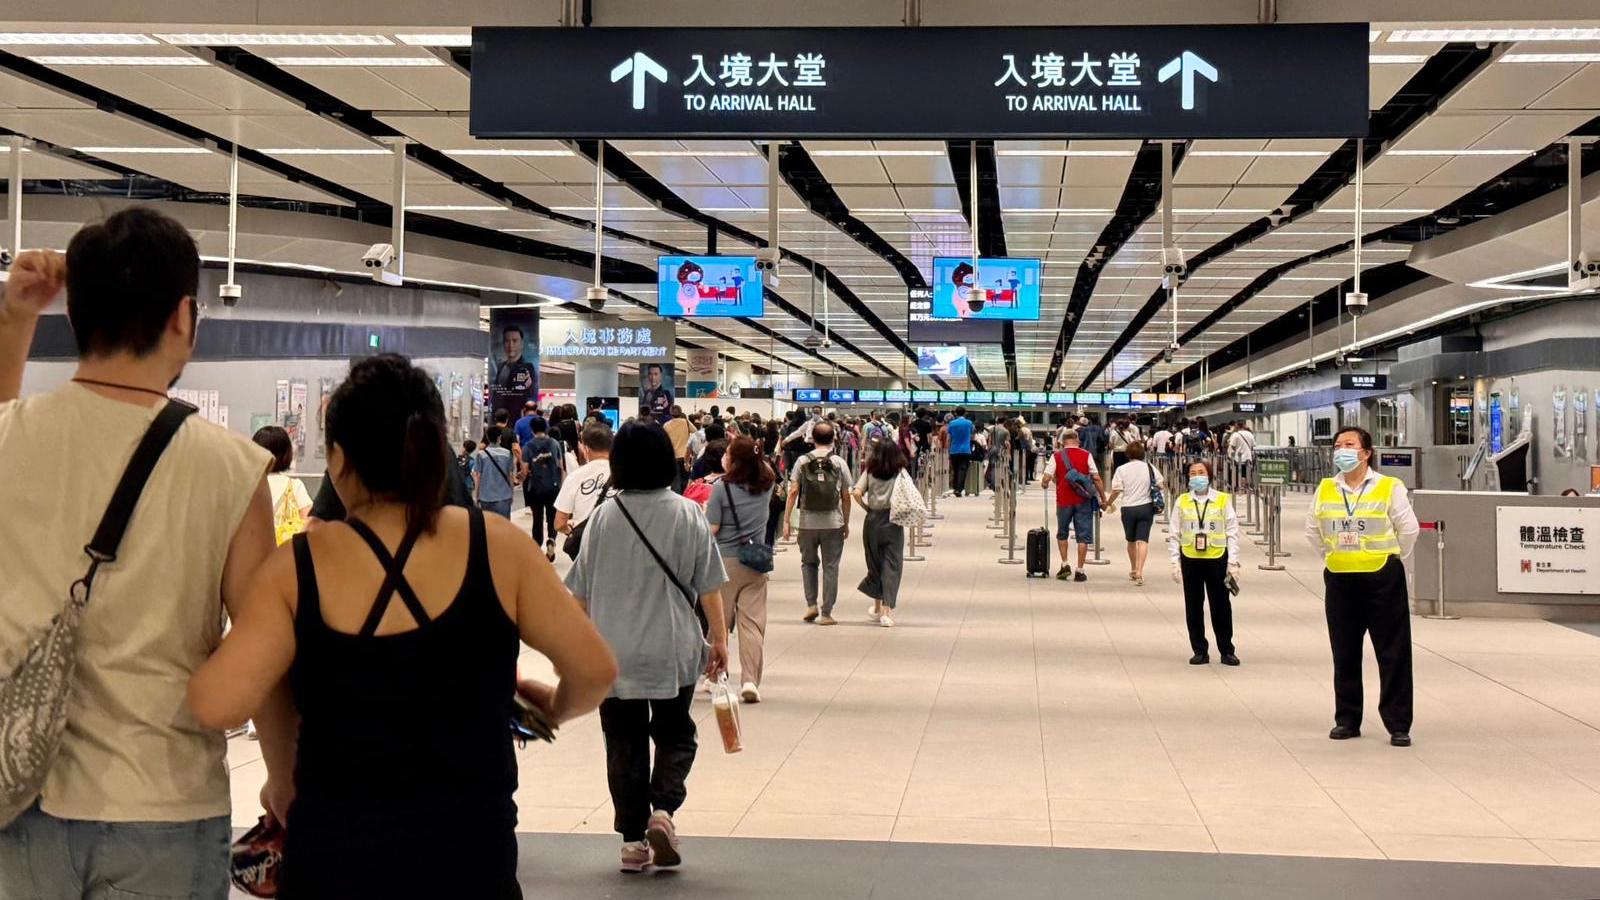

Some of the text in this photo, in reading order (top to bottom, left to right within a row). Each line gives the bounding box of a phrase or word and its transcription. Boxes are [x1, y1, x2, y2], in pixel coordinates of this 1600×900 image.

[683, 52, 827, 88] 入境大堂
[995, 52, 1142, 88] 入境大堂
[684, 94, 817, 111] TO ARRIVAL HALL
[1006, 94, 1142, 111] TO ARRIVAL HALL
[546, 345, 667, 357] IMMIGRATION DEPARTMENT
[1520, 526, 1585, 543] 體溫檢查
[1520, 542, 1562, 550] Temperature
